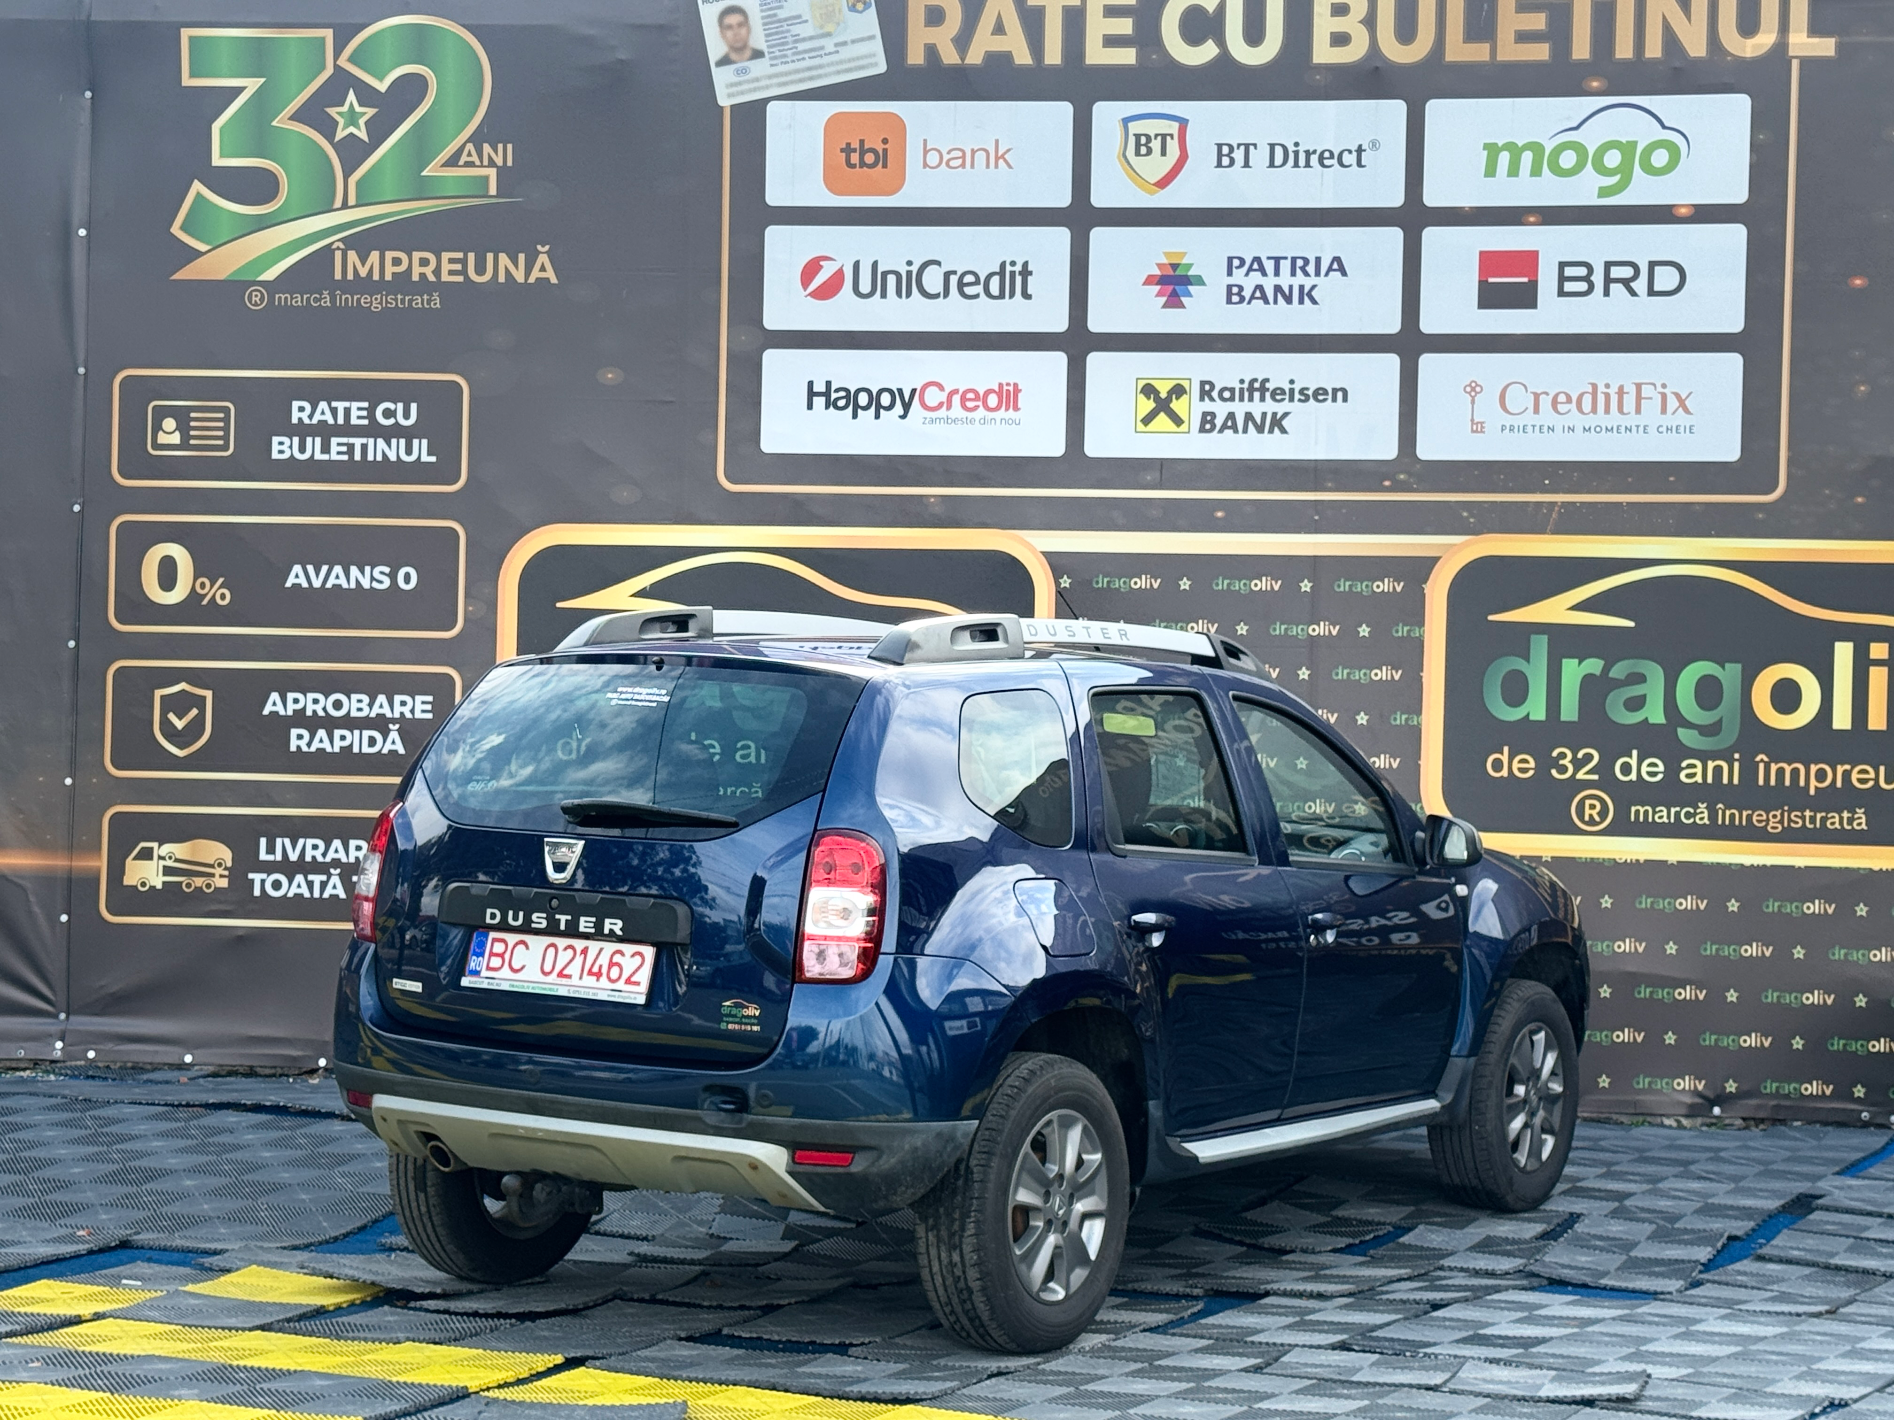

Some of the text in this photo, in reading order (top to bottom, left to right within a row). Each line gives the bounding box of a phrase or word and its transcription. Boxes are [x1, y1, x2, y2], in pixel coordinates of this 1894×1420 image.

[170, 14, 497, 253] 32
[1133, 133, 1174, 158] BT
[458, 143, 513, 167] ANI
[840, 137, 1014, 170] tbi bank
[1214, 143, 1257, 169] BT
[1482, 138, 1683, 199] mogo
[331, 242, 559, 285] ÎMPREUNĂ
[1226, 255, 1348, 278] PATRIA
[852, 259, 1033, 301] UniCredit
[1556, 260, 1687, 298] BRD
[274, 289, 331, 308] marcă
[335, 290, 441, 313] înregistrată
[1226, 283, 1320, 306] BANK
[807, 380, 1022, 420] HappyCredit
[1199, 378, 1349, 403] Raiffeisen
[1499, 381, 1694, 417] CreditFix
[291, 401, 418, 426] RATE CU
[922, 415, 1022, 426] zambeste din nou
[1199, 411, 1290, 434] BANK
[1501, 425, 1696, 435] PRIETEN IN MOMENTE CHEIE
[271, 437, 437, 464] BULETINUL
[285, 565, 418, 590] AVANS 0
[1092, 574, 1404, 596] dragoliv dragoliv dragoliv
[1026, 624, 1130, 641] DUSTER
[1270, 621, 1340, 638] dragoliv
[1332, 666, 1402, 683] dragoliv
[1482, 634, 1889, 750] dragoli
[262, 692, 433, 719] APROBARE
[289, 724, 405, 754] RAPIDĂ
[1487, 747, 1535, 778] de
[1551, 749, 1599, 781] 32
[1615, 750, 1664, 782] de
[1680, 754, 1740, 786] ani
[1631, 803, 1709, 825] marcă
[1717, 803, 1868, 834] înregistrată
[248, 868, 347, 899] TOATĂ
[1635, 895, 1836, 917] dragoliv dragoliv
[485, 908, 624, 936] DUSTER
[1587, 938, 1646, 956] ragoliv
[1700, 941, 1773, 960] dragoliv
[469, 956, 483, 971] RO
[485, 937, 646, 987] BC 021462
[1634, 984, 1835, 1008] dragoliv dragoliv
[721, 1005, 761, 1018] dragoliv
[1585, 1028, 1645, 1046] ragoliv
[1700, 1032, 1773, 1051] dragoliv
[1633, 1074, 1834, 1098] dragoliv dragoliv
